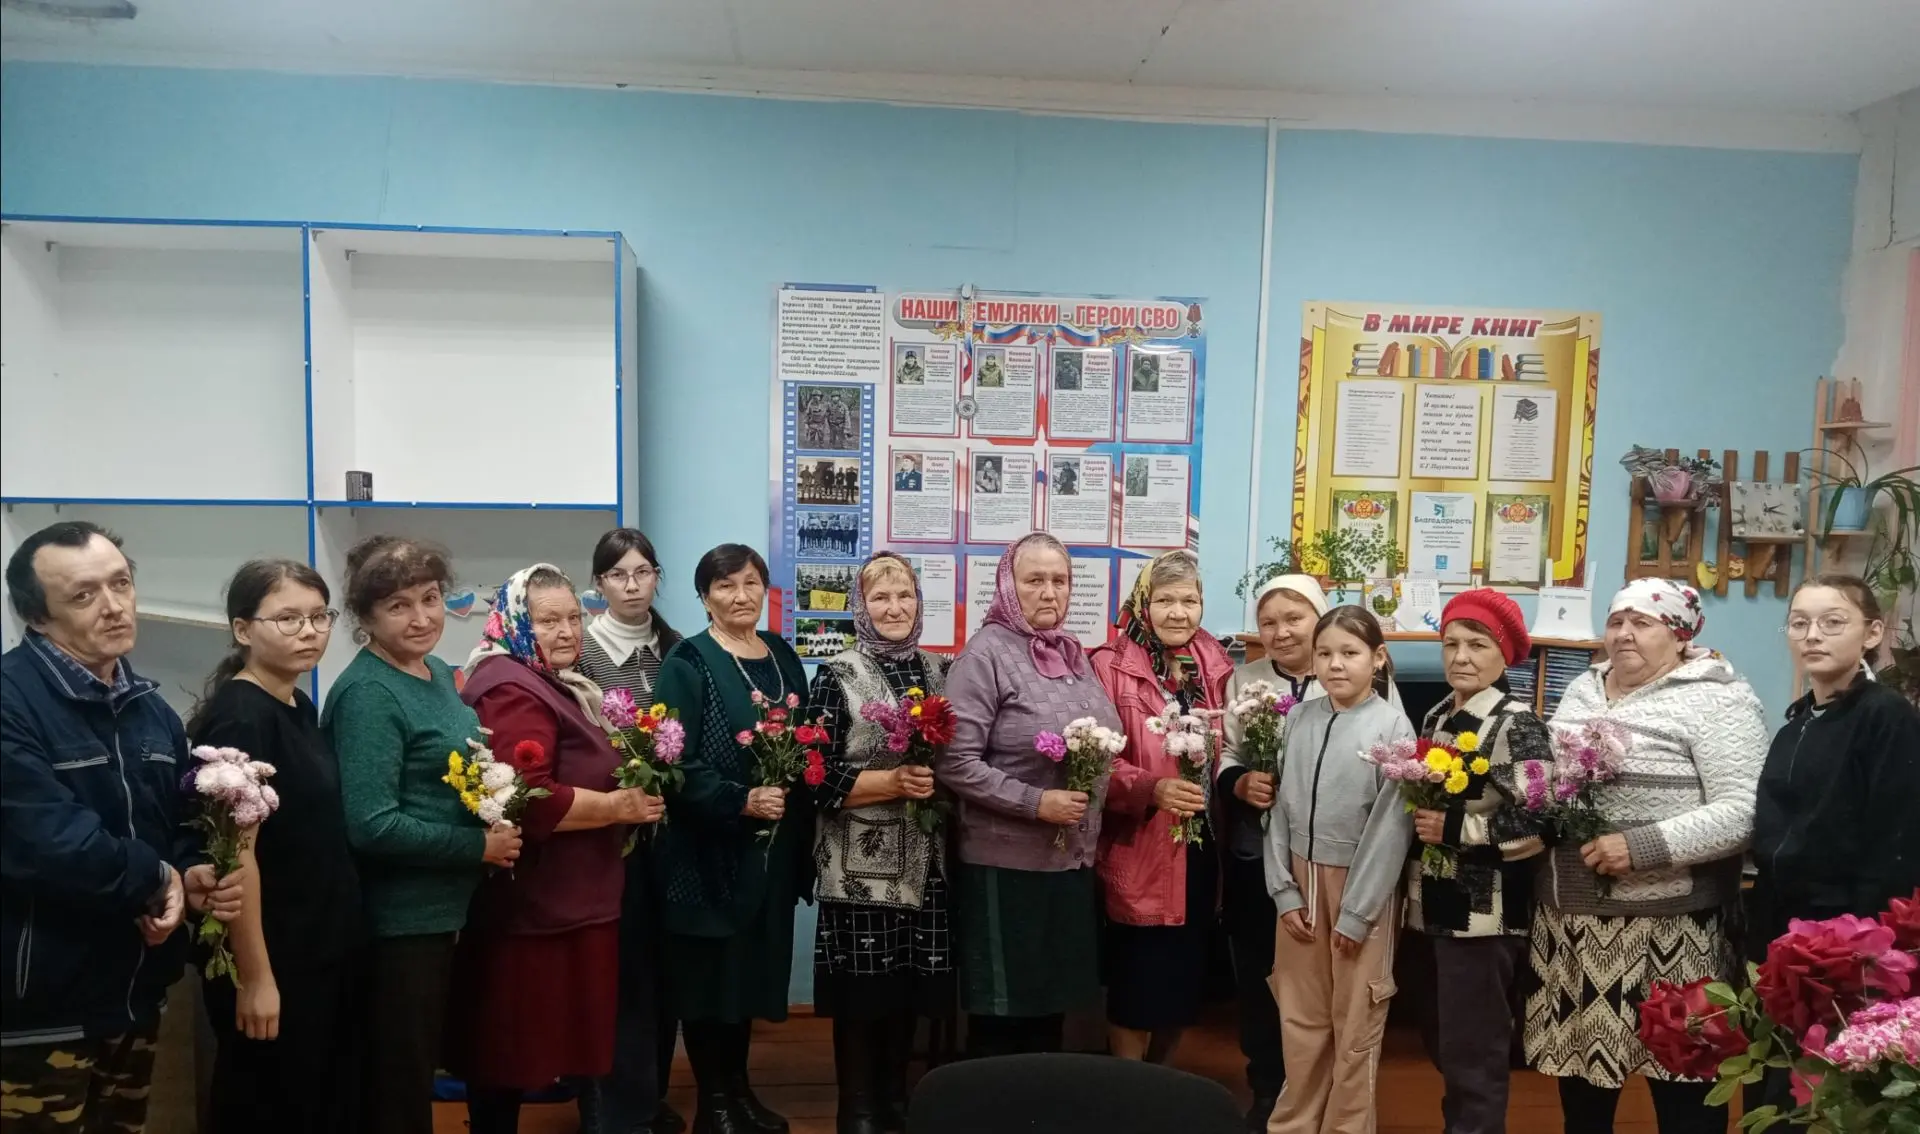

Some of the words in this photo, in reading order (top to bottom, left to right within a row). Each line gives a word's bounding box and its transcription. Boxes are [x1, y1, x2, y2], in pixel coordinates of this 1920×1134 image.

[901, 298, 958, 321] НАШИ
[972, 301, 1057, 324] ЕМЛЯКИ
[1076, 305, 1137, 326] ГЕРОИ
[1141, 307, 1178, 328] СВО
[1364, 314, 1381, 332] В
[1388, 315, 1464, 335] МИРЕ
[1471, 317, 1542, 337] КНИГ
[1414, 516, 1472, 524] Благодарность
